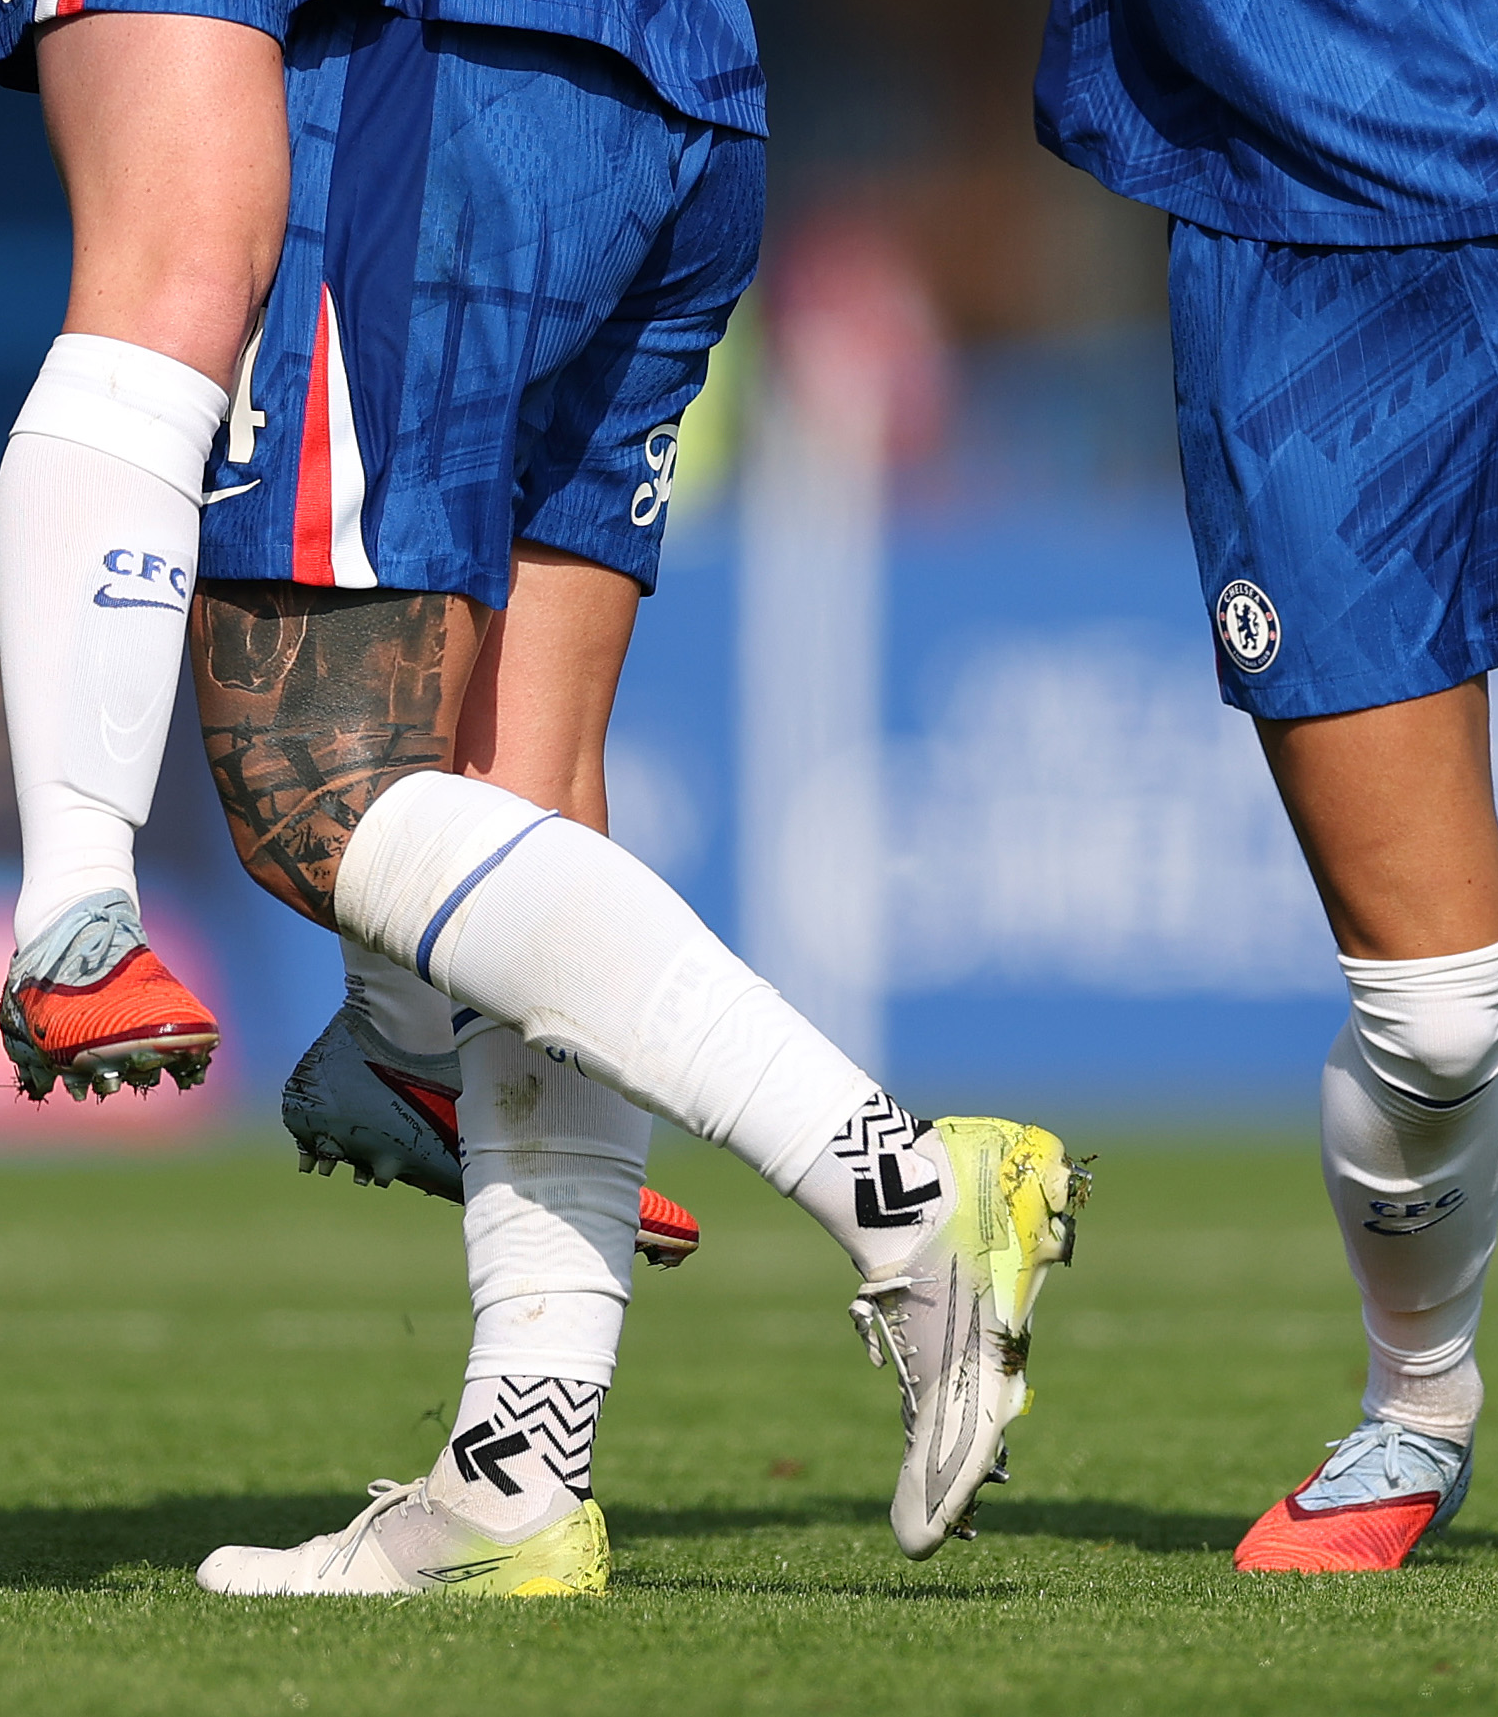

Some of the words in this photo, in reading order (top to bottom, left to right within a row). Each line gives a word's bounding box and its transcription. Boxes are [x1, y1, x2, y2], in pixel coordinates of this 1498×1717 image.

[103, 548, 187, 600] CFC
[1223, 584, 1261, 604] CHELSEA
[1369, 1188, 1465, 1218] CFC
